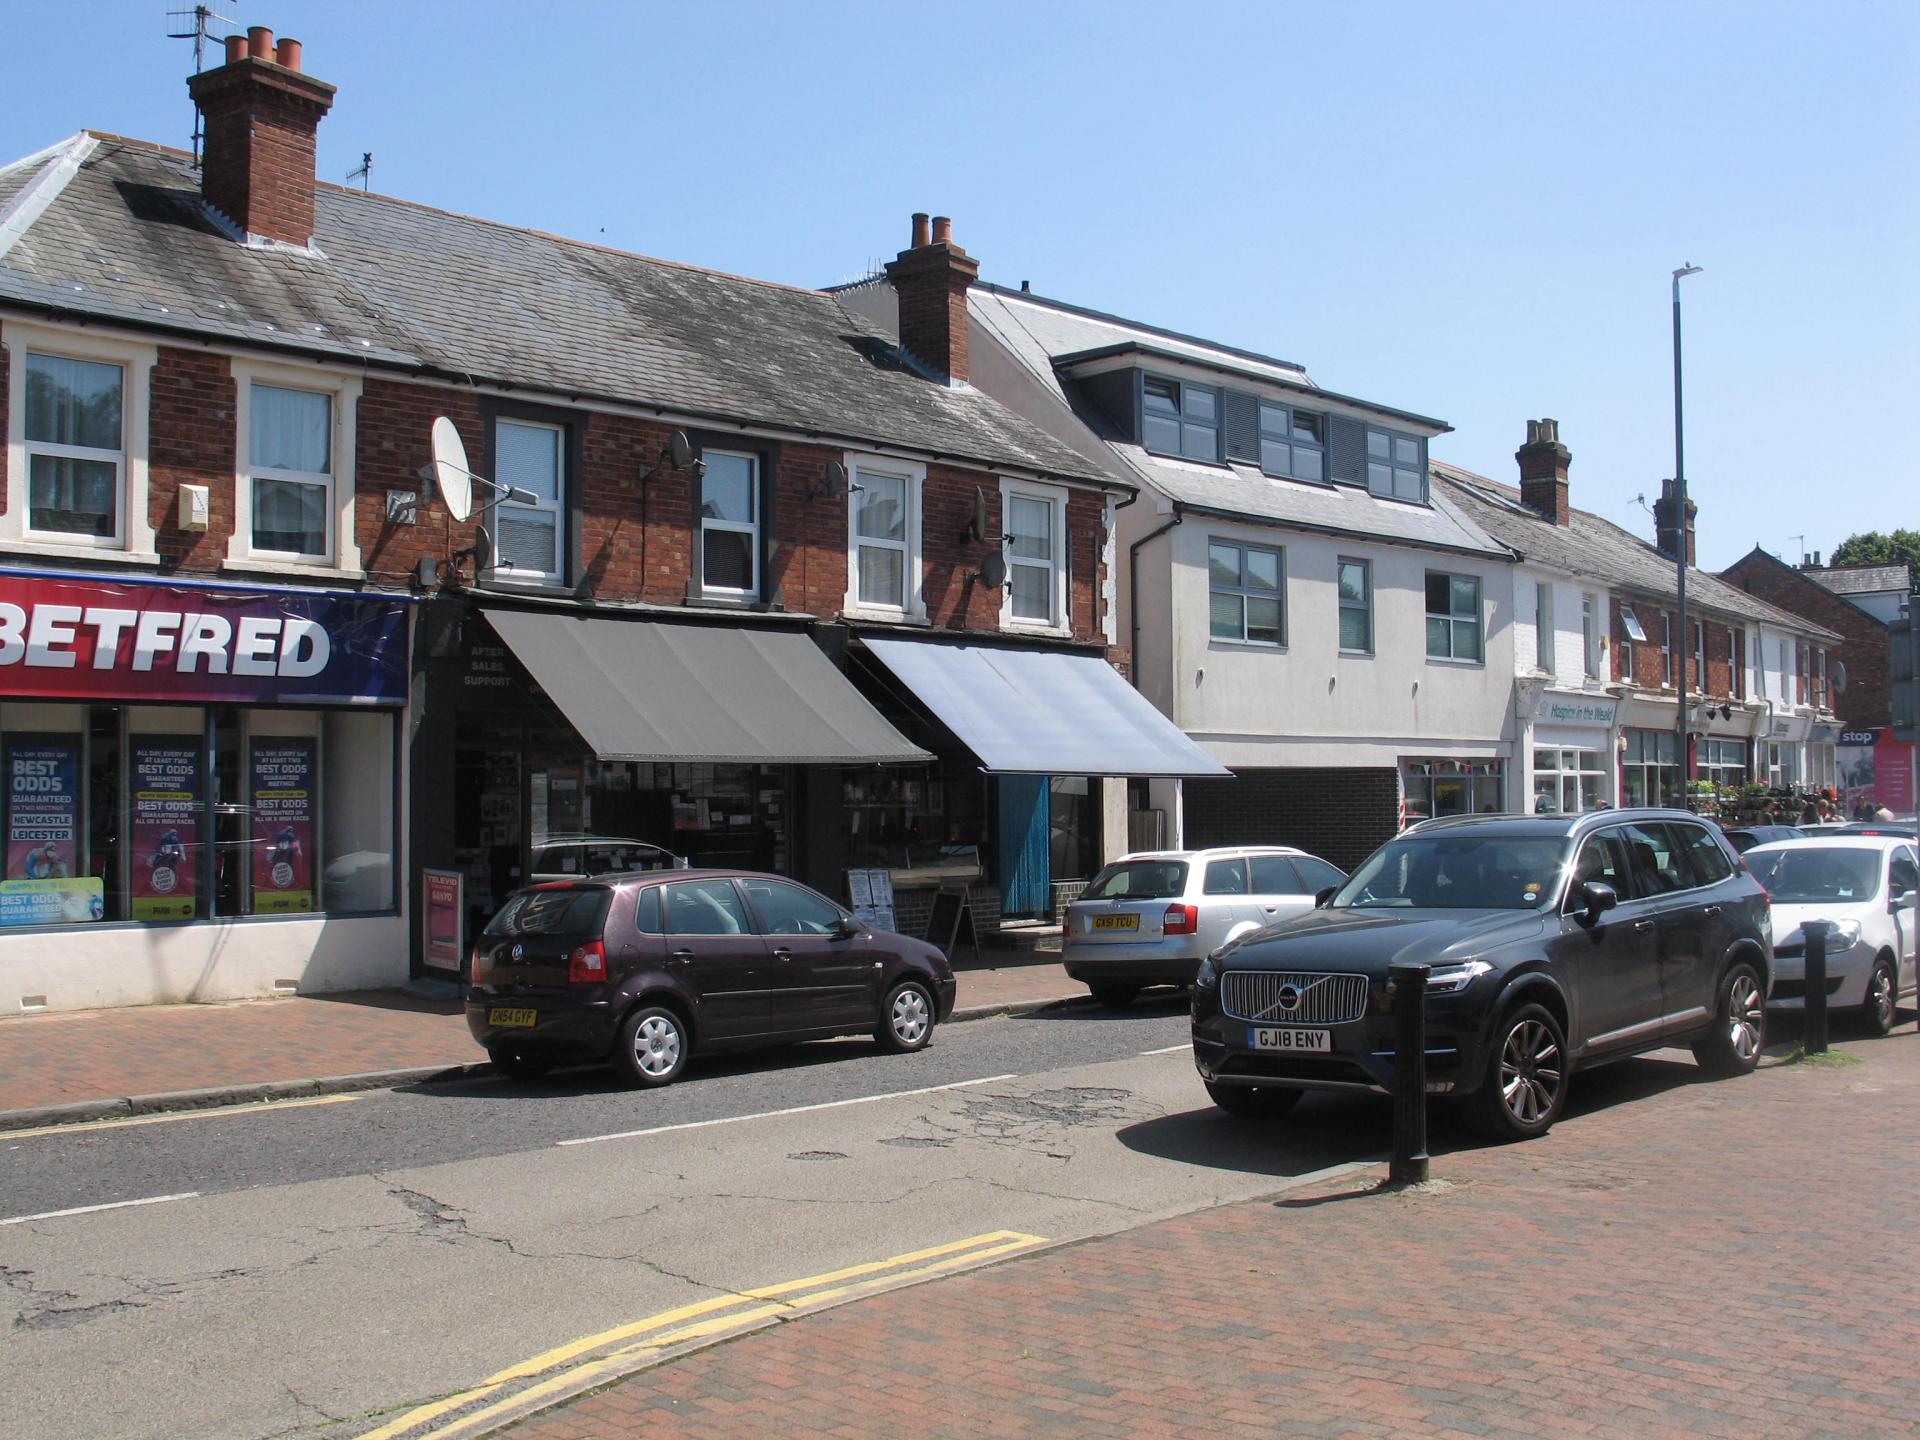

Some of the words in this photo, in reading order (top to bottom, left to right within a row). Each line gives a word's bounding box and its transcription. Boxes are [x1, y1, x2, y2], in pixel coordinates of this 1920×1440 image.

[471, 647, 504, 656] AFTER
[471, 661, 504, 671] SALES
[464, 676, 512, 687] SUPPORT
[1583, 706, 1594, 720] the
[1842, 731, 1872, 744] stop
[13, 760, 58, 775] BEST
[138, 764, 164, 774] BEST
[166, 765, 194, 775] ODDS
[255, 764, 280, 774] BEST
[281, 764, 308, 774] ODDS
[13, 776, 62, 791] ODDS
[12, 794, 72, 803] GUARANTEED
[256, 799, 280, 809] BEST
[282, 799, 308, 808] ODDS
[137, 800, 163, 811] BEST
[165, 801, 194, 811] ODDS
[14, 816, 70, 824] NEWCASTLE
[13, 830, 69, 840] LEICESTER
[0, 895, 29, 905] BEST
[31, 893, 61, 904] ODDS
[0, 904, 61, 914] GUARANTEED
[1116, 917, 1132, 928] TCU
[515, 1010, 534, 1025] GYF
[1259, 1030, 1292, 1047] GJ18
[1295, 1031, 1325, 1048] ENY
